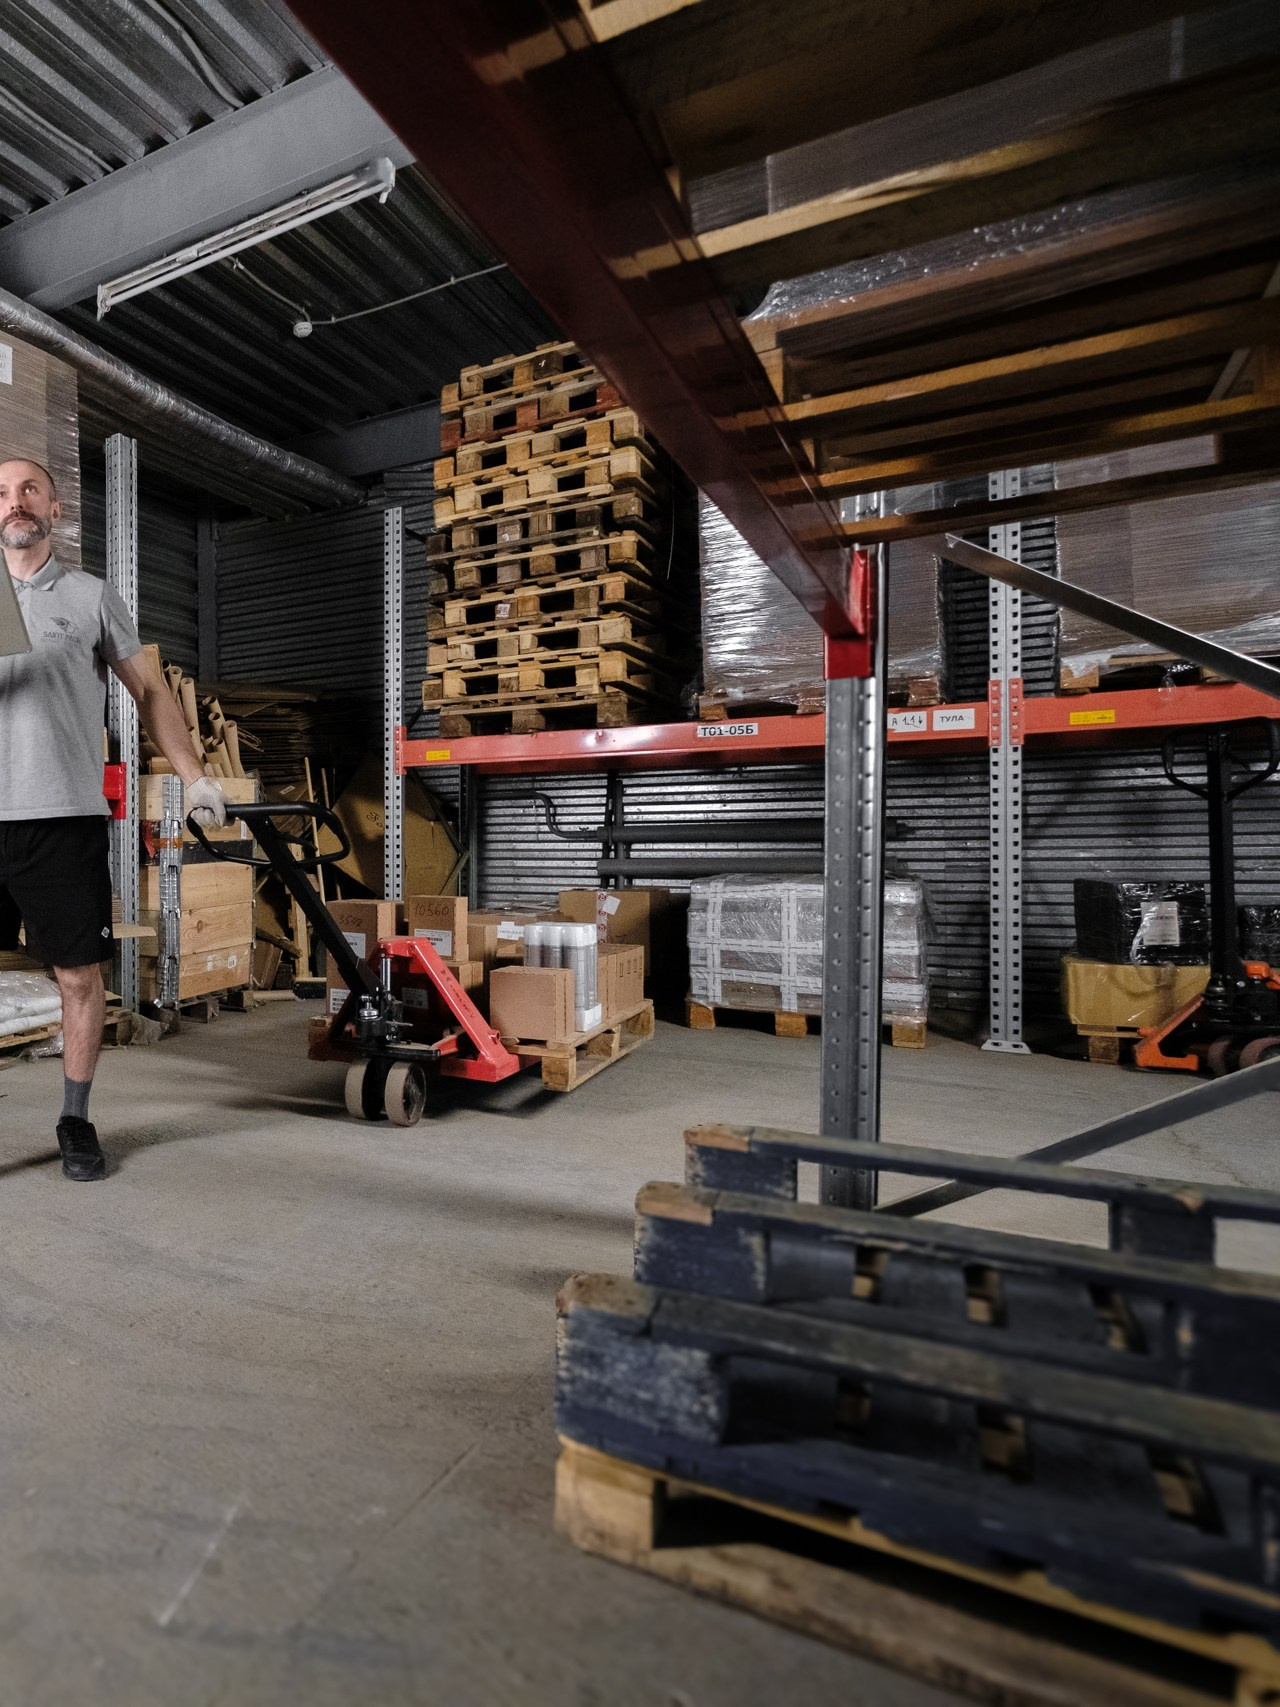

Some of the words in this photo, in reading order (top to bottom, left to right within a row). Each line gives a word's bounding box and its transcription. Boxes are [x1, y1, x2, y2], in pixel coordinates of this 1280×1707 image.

[940, 715, 964, 723] ТУЛА
[701, 724, 754, 737] Т01-05Б
[412, 902, 450, 917] 10560
